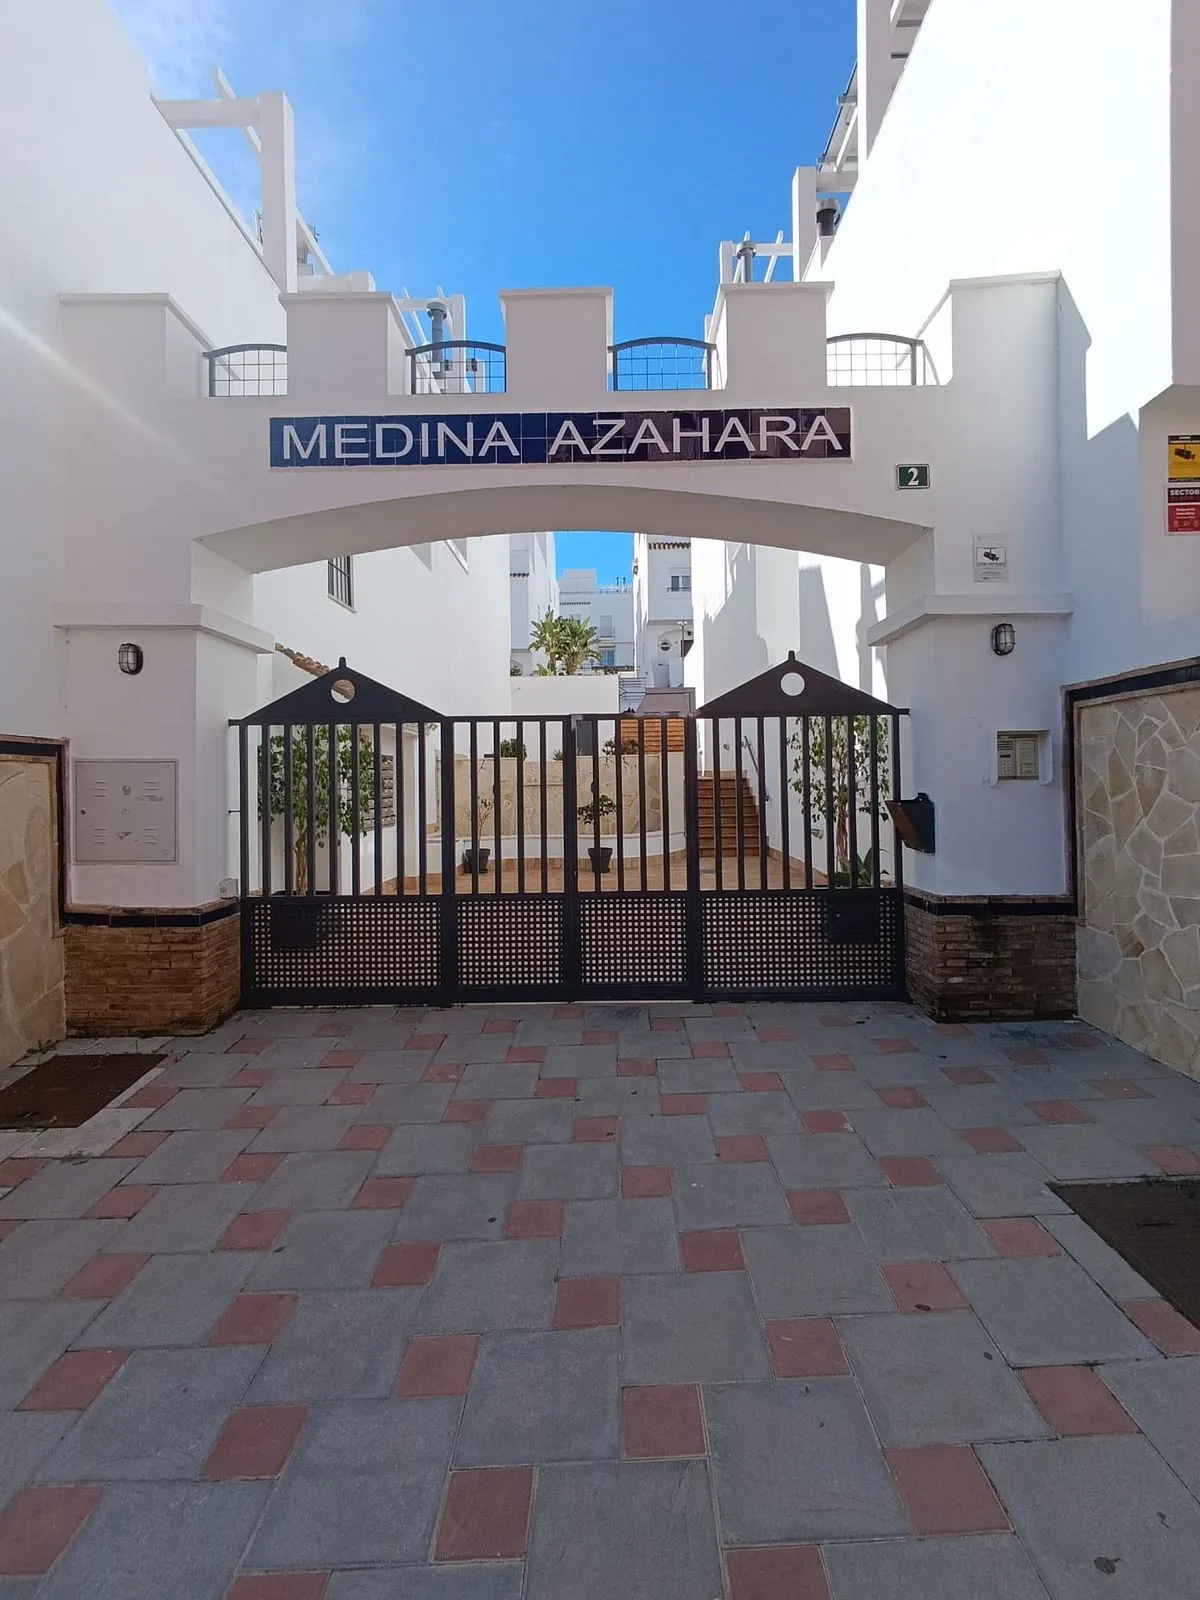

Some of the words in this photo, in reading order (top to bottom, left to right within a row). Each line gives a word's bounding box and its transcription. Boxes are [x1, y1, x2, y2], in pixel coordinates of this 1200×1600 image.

[283, 421, 520, 460] MEDINA
[548, 415, 843, 455] AZAHARA
[907, 467, 920, 486] 2
